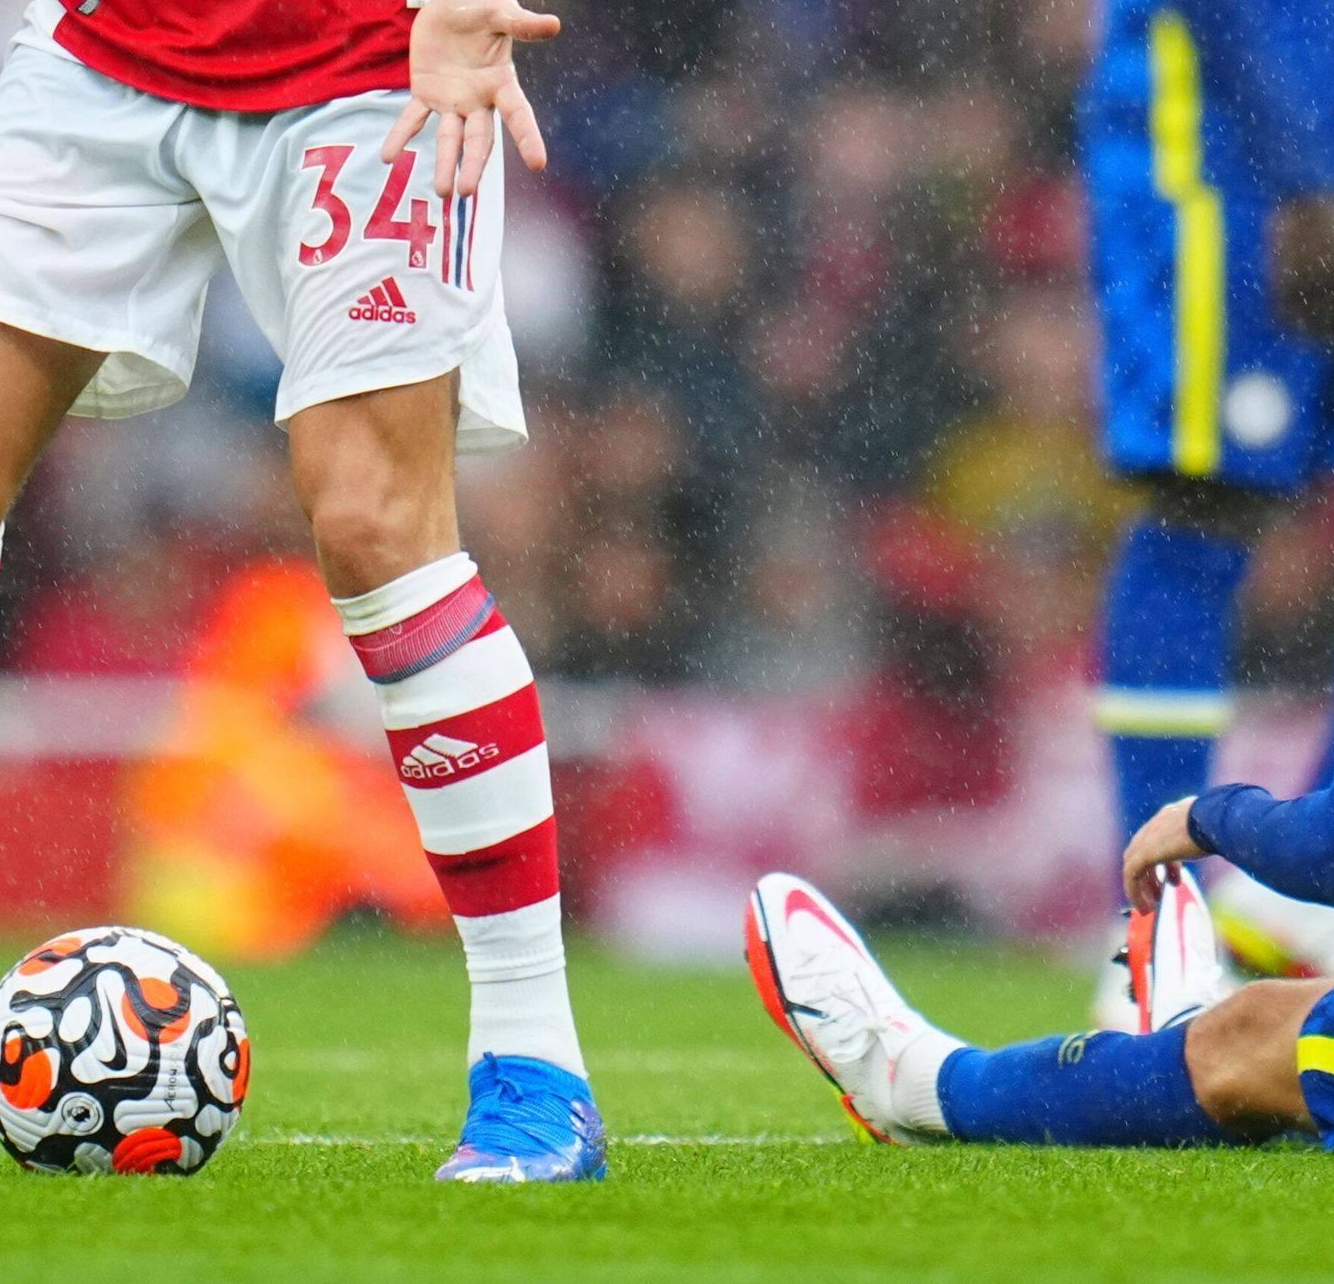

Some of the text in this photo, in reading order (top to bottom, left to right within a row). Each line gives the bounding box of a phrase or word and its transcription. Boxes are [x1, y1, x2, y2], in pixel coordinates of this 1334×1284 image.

[298, 144, 438, 270] 34
[348, 306, 417, 325] adidas
[400, 742, 500, 780] adidas
